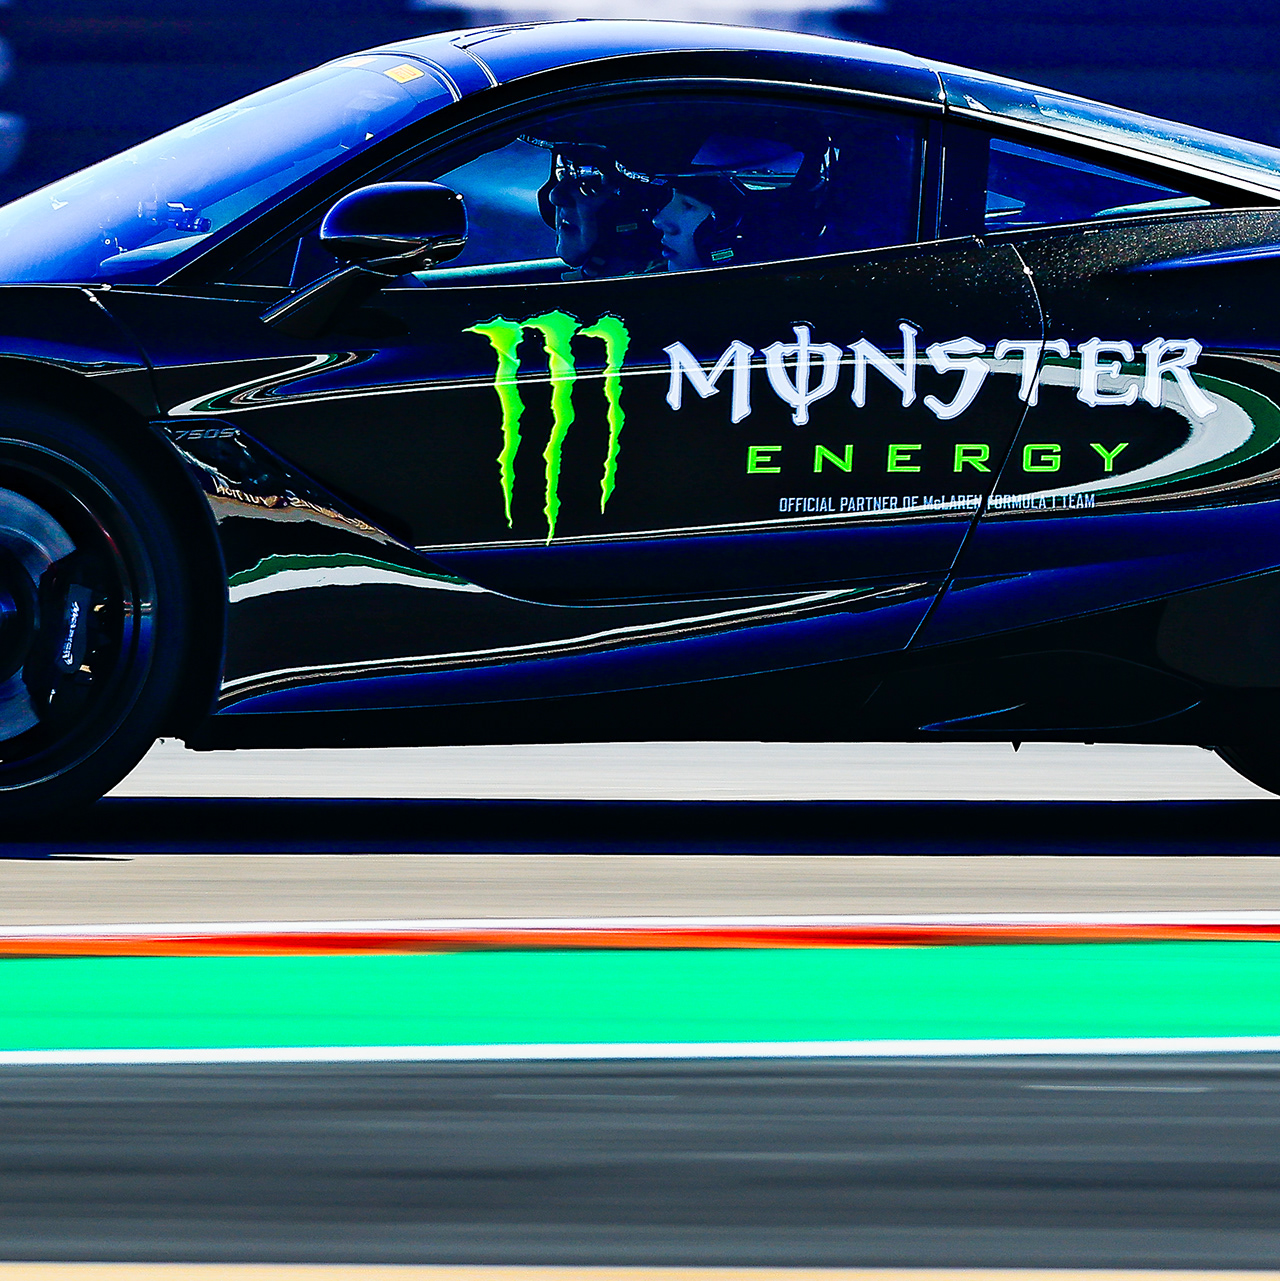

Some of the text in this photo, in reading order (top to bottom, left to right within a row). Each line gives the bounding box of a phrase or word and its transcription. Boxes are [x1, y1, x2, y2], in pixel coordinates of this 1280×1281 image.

[662, 322, 1218, 426] MONSTER
[175, 427, 237, 441] 750S
[746, 442, 1129, 474] ENERGY
[779, 496, 836, 513] OFFICIAL
[839, 495, 898, 512] PARTNER
[902, 495, 919, 511] OF
[923, 494, 982, 511] McLAREN
[987, 493, 1047, 510] FORMULA
[1062, 493, 1096, 509] TEAM
